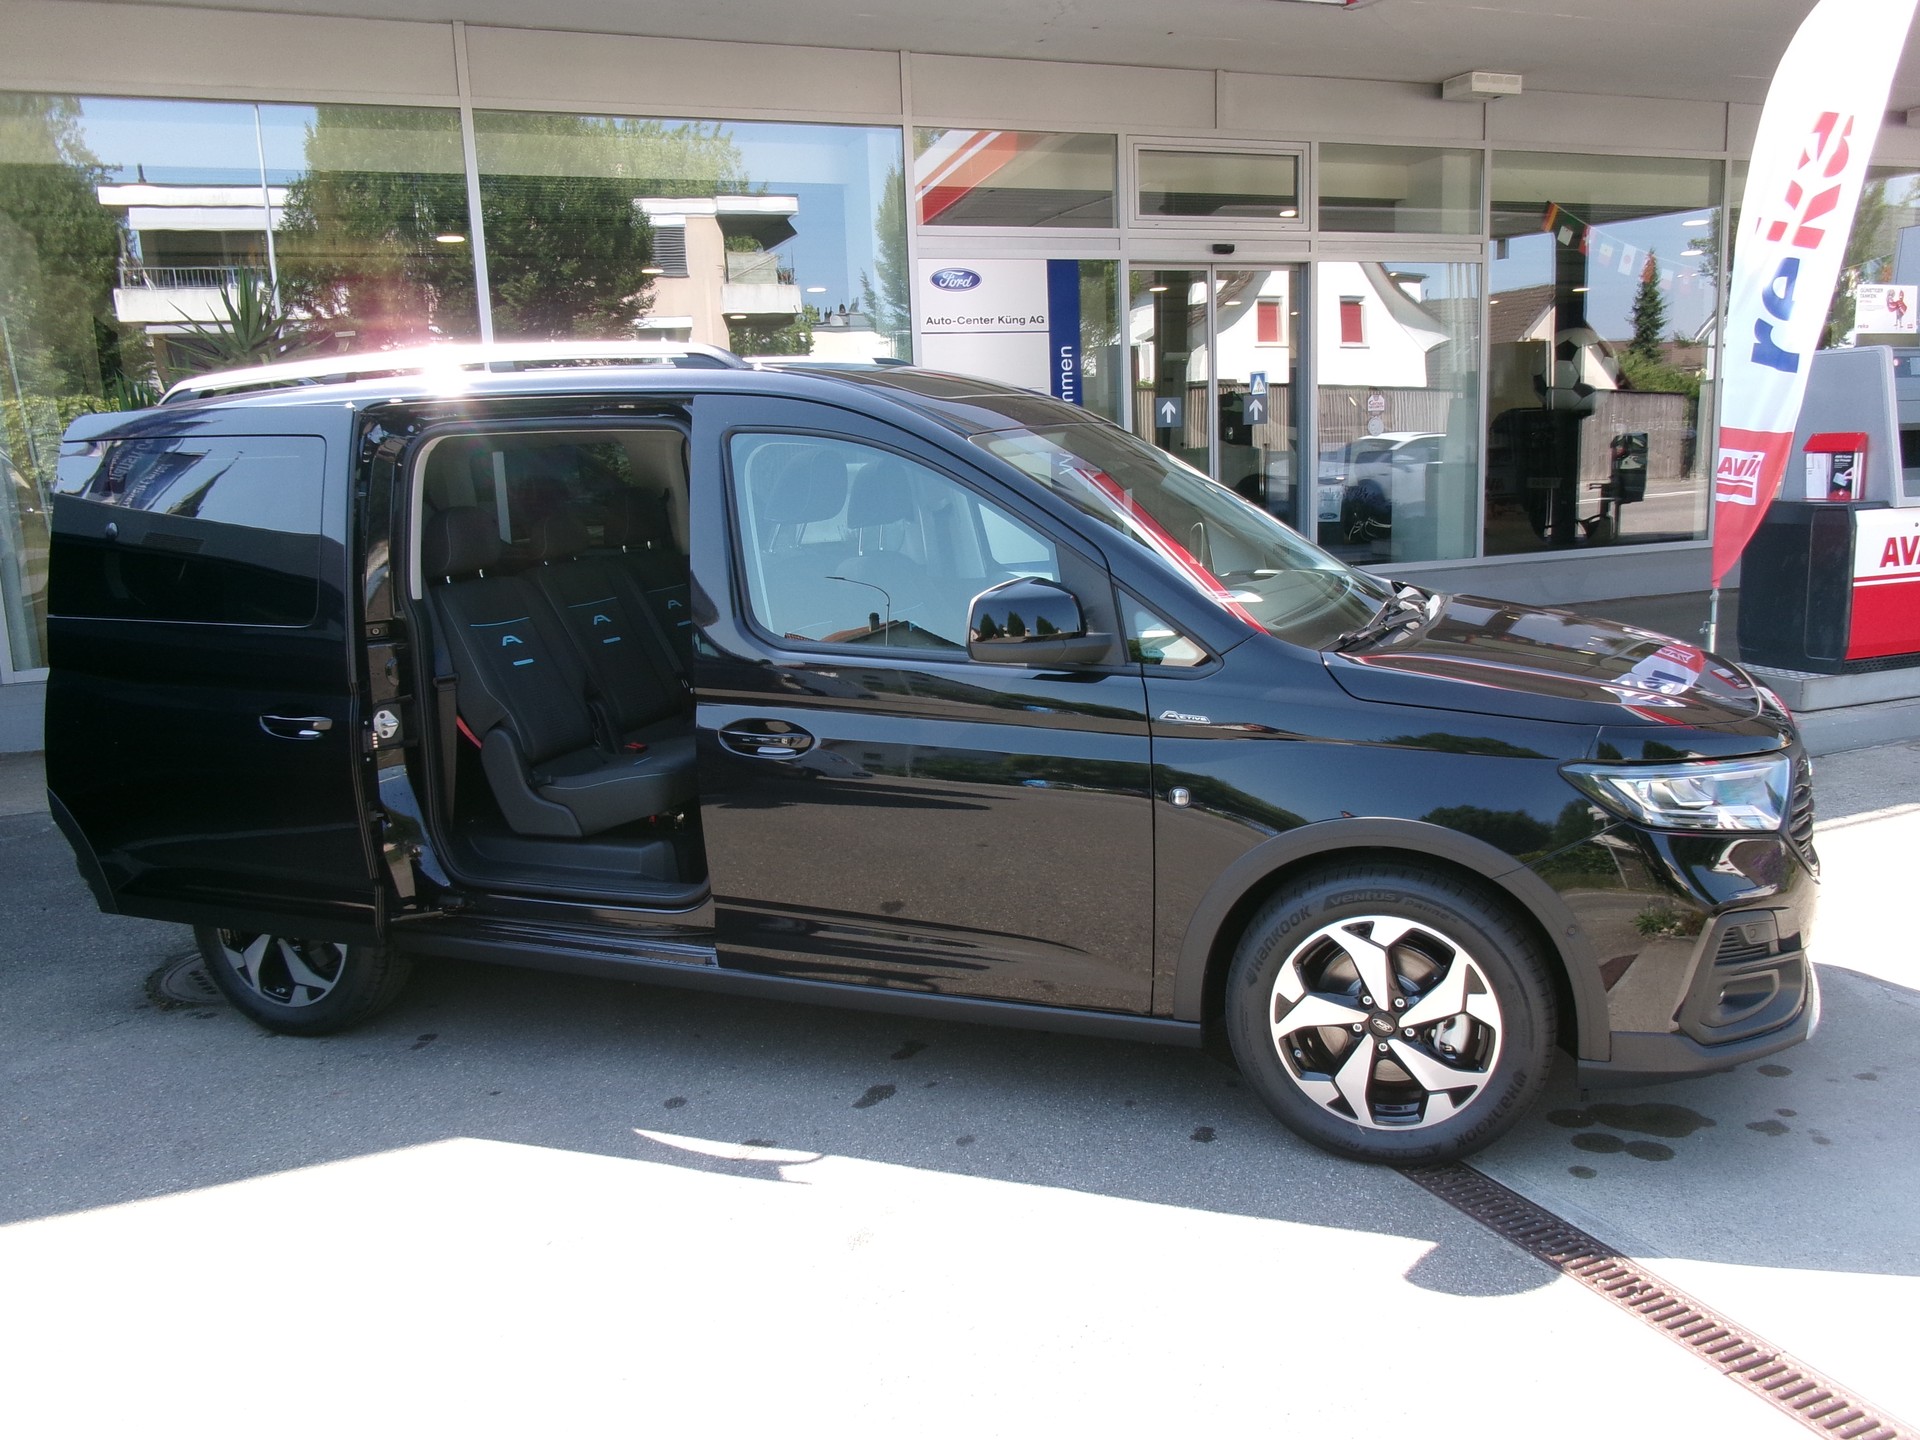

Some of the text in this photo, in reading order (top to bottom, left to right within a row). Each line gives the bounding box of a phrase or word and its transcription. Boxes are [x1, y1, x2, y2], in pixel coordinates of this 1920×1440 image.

[1751, 111, 1855, 374] reka
[926, 315, 1045, 326] Auto-Center Küng AG
[1879, 535, 1920, 568] AV
